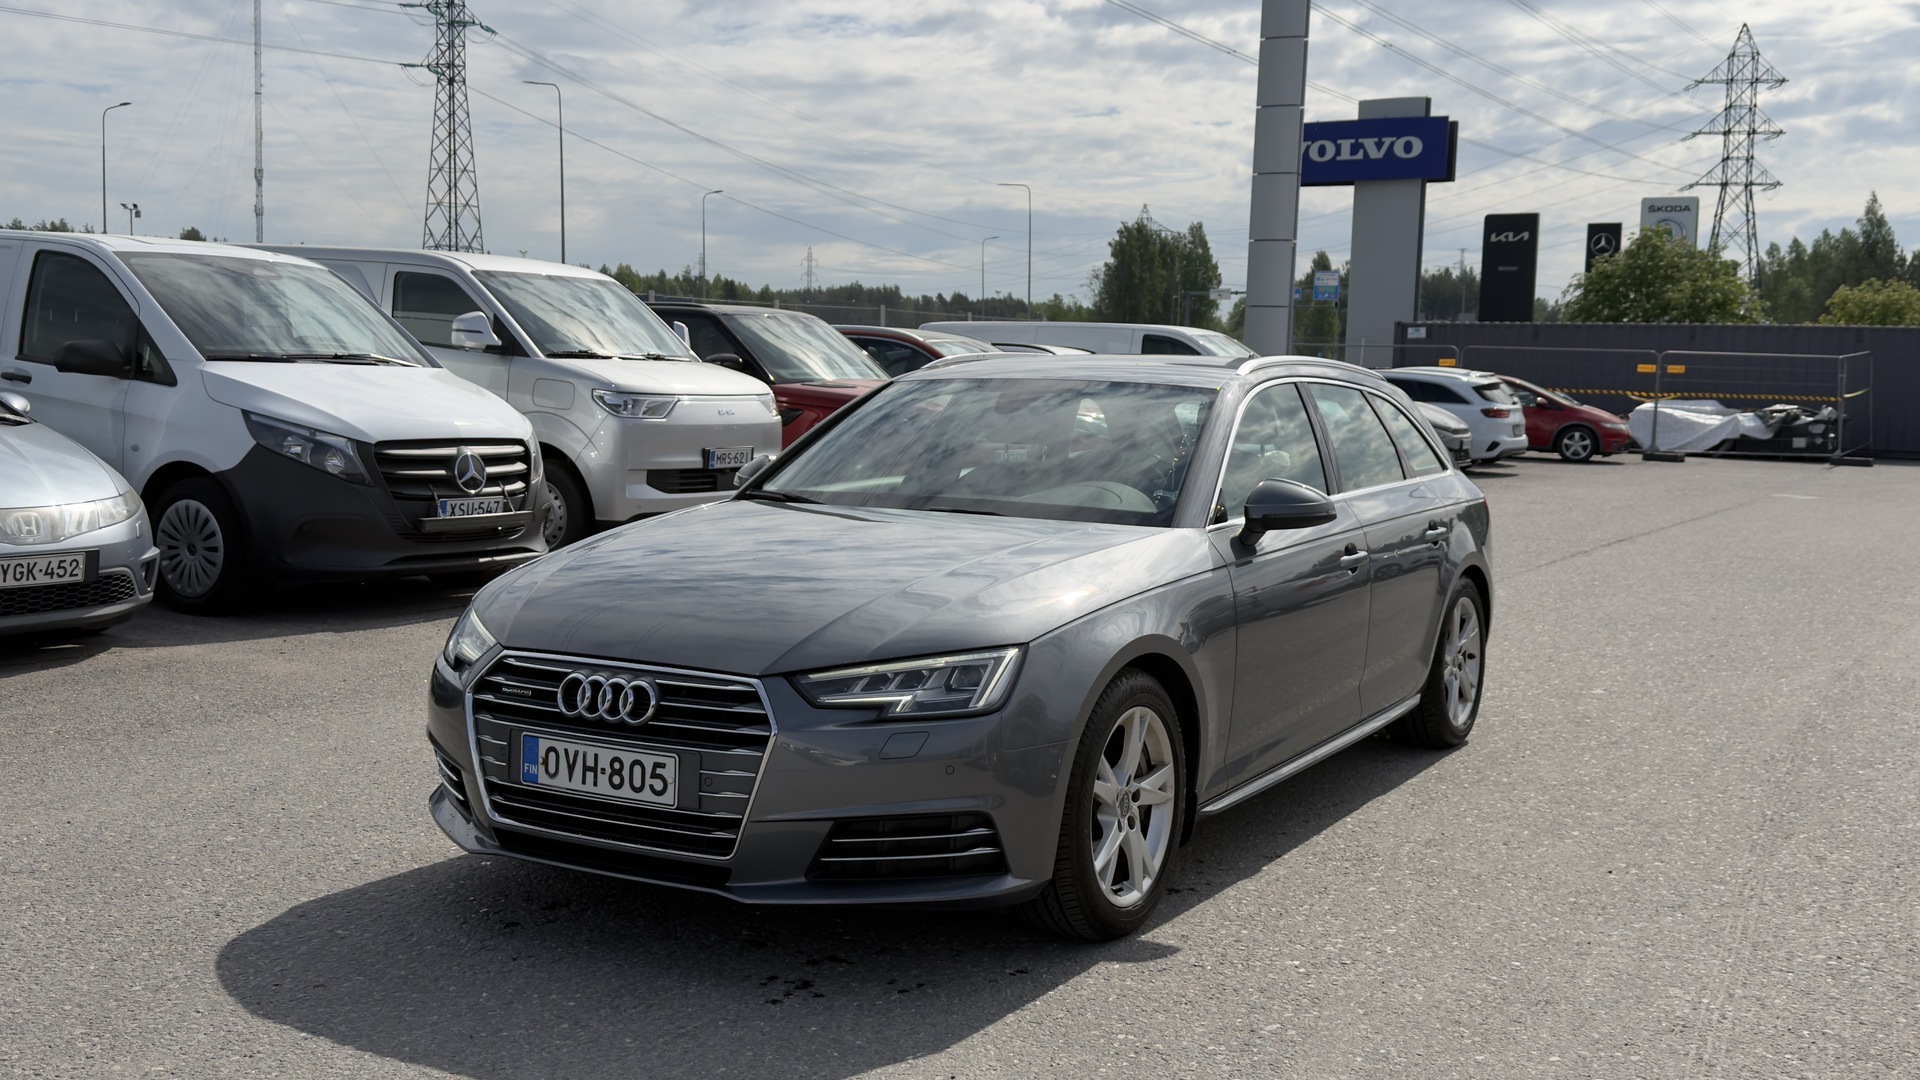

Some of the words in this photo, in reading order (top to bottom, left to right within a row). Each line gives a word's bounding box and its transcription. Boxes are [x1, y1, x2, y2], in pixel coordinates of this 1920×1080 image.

[715, 451, 749, 465] MRS-621
[449, 501, 500, 517] XSU-547
[0, 558, 80, 583] YGK-452
[524, 763, 538, 775] FIN
[544, 746, 669, 796] OVH-805
